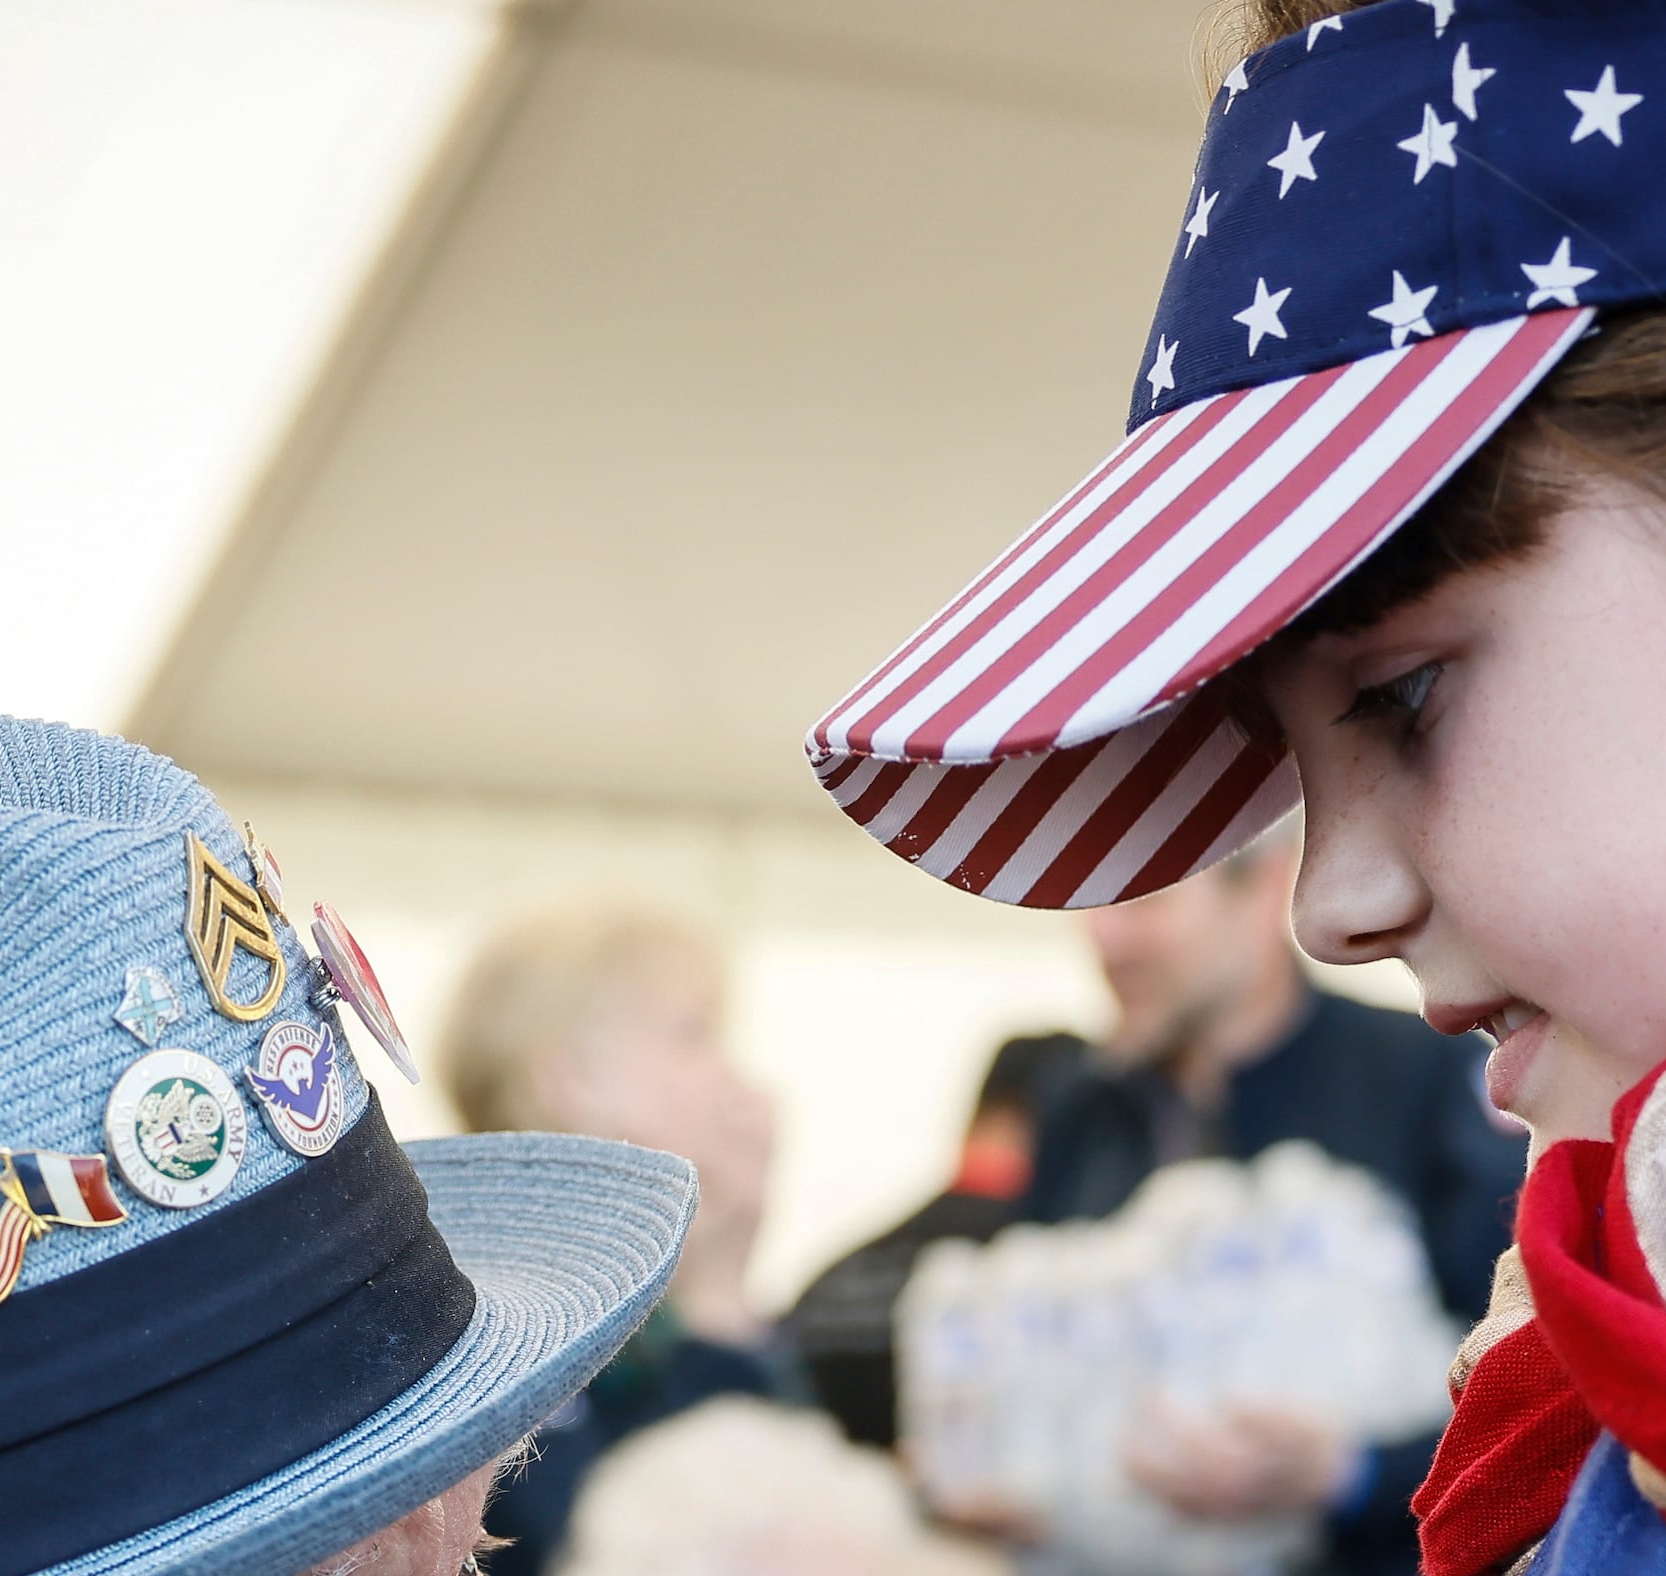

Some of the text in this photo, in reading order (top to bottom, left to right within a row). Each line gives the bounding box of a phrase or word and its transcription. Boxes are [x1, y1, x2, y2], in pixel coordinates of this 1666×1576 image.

[116, 1101, 178, 1203] VETERAN
[219, 1088, 245, 1165] ARMY
[298, 1111, 339, 1149] FOUNDATION
